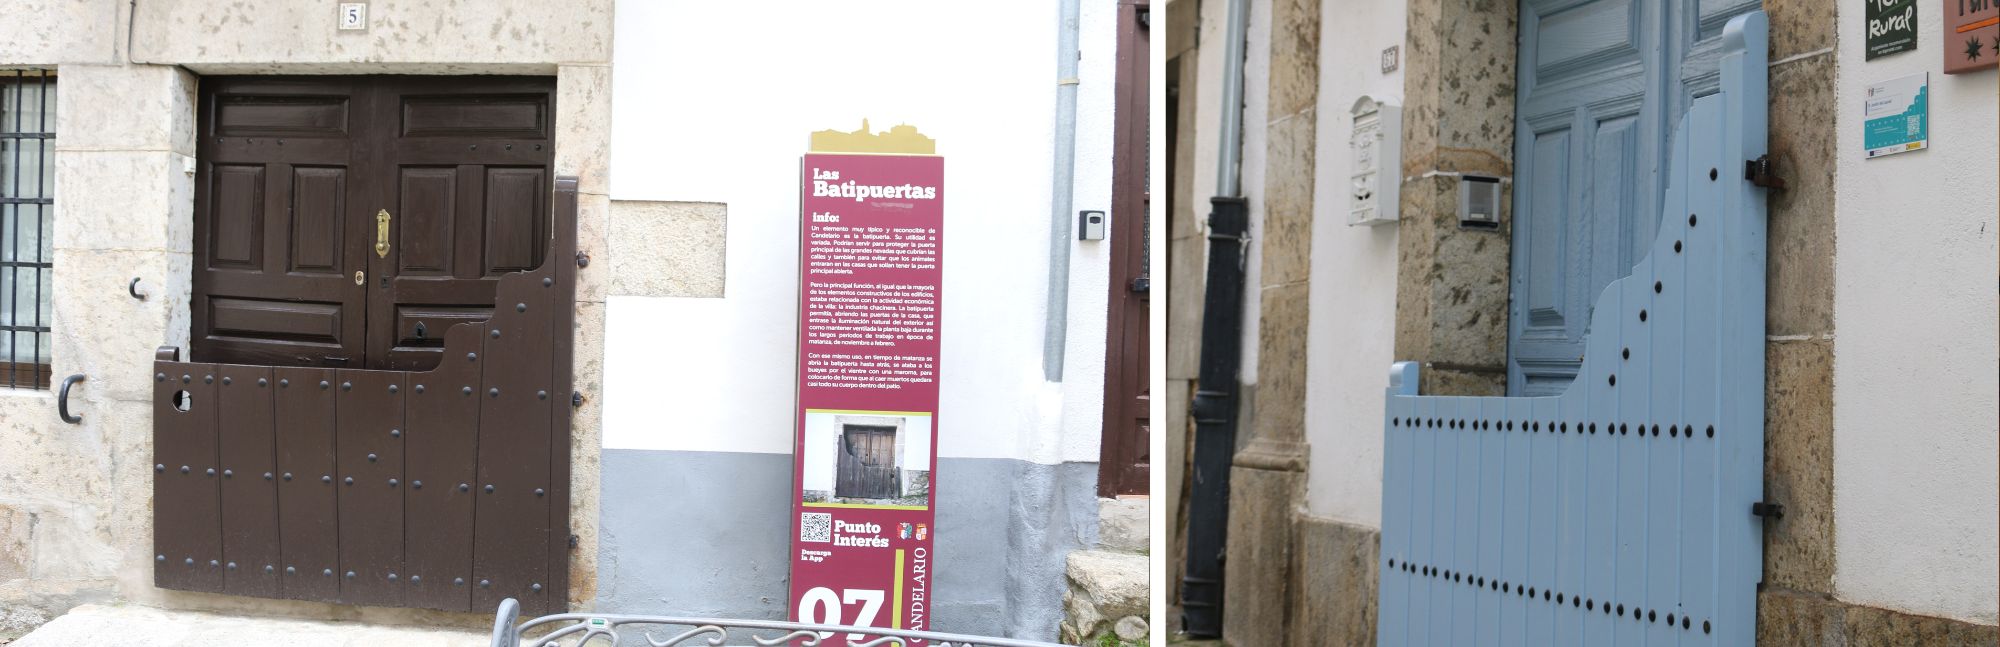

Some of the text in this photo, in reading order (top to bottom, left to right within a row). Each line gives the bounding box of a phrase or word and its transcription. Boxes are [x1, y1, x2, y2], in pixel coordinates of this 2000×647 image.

[349, 9, 357, 24] 5
[1869, 5, 1913, 39] Rural
[813, 168, 839, 180] Las
[813, 180, 936, 202] Batipuertas
[812, 212, 840, 223] info:
[834, 520, 881, 534] Punto
[833, 534, 890, 548] Interés
[801, 549, 832, 557] Descarga
[798, 587, 885, 641] 07
